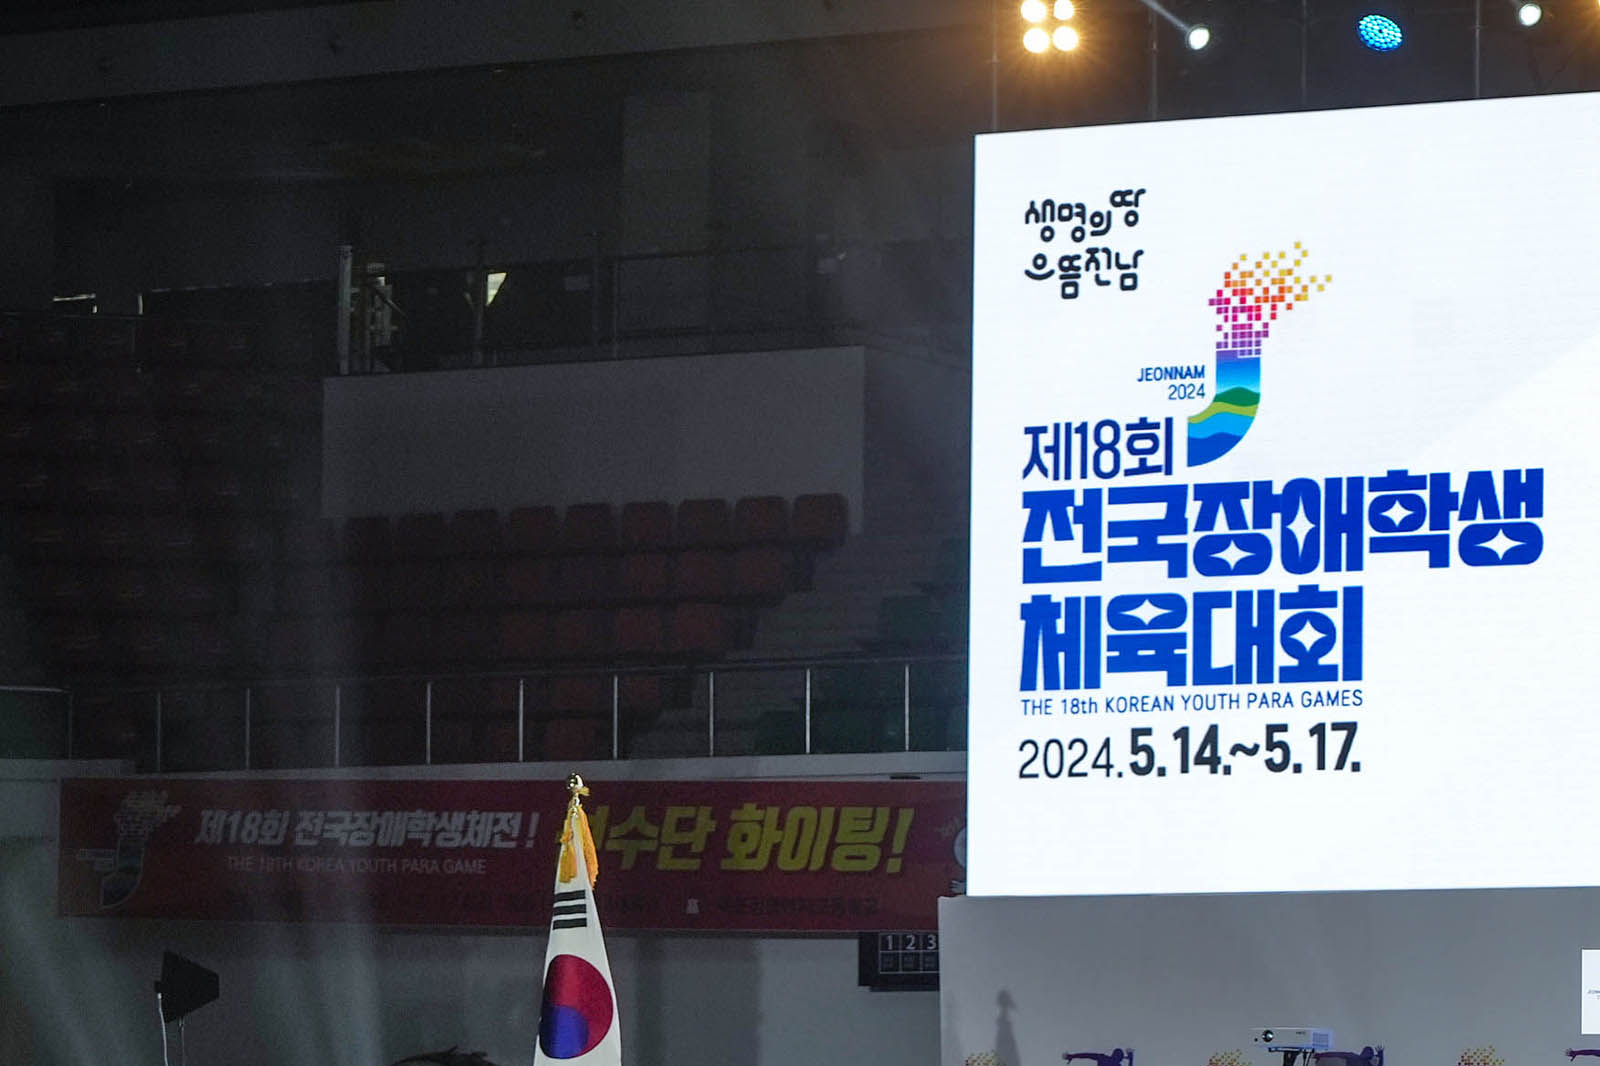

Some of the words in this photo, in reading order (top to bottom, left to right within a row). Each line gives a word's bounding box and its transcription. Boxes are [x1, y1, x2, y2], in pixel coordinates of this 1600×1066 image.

[1137, 365, 1205, 382] JEONNAM
[1168, 383, 1206, 400] 2024
[1022, 416, 1174, 480] 제18회
[1022, 468, 1544, 584] 전국장애학생
[1019, 584, 1363, 692] 체육대회
[1021, 698, 1053, 716] THE
[1061, 697, 1098, 715] 18th
[1105, 695, 1174, 714] KOREAN
[1181, 693, 1240, 712] YOUTH
[1246, 691, 1294, 710] PARA
[1300, 689, 1363, 708] GAMES
[194, 809, 287, 848] 제18회
[720, 804, 915, 873] 화이팅!
[350, 857, 397, 873] YOUTH
[402, 858, 439, 874] PARA
[443, 859, 486, 874] GAME
[906, 935, 916, 950] 2
[927, 934, 937, 950] 3
